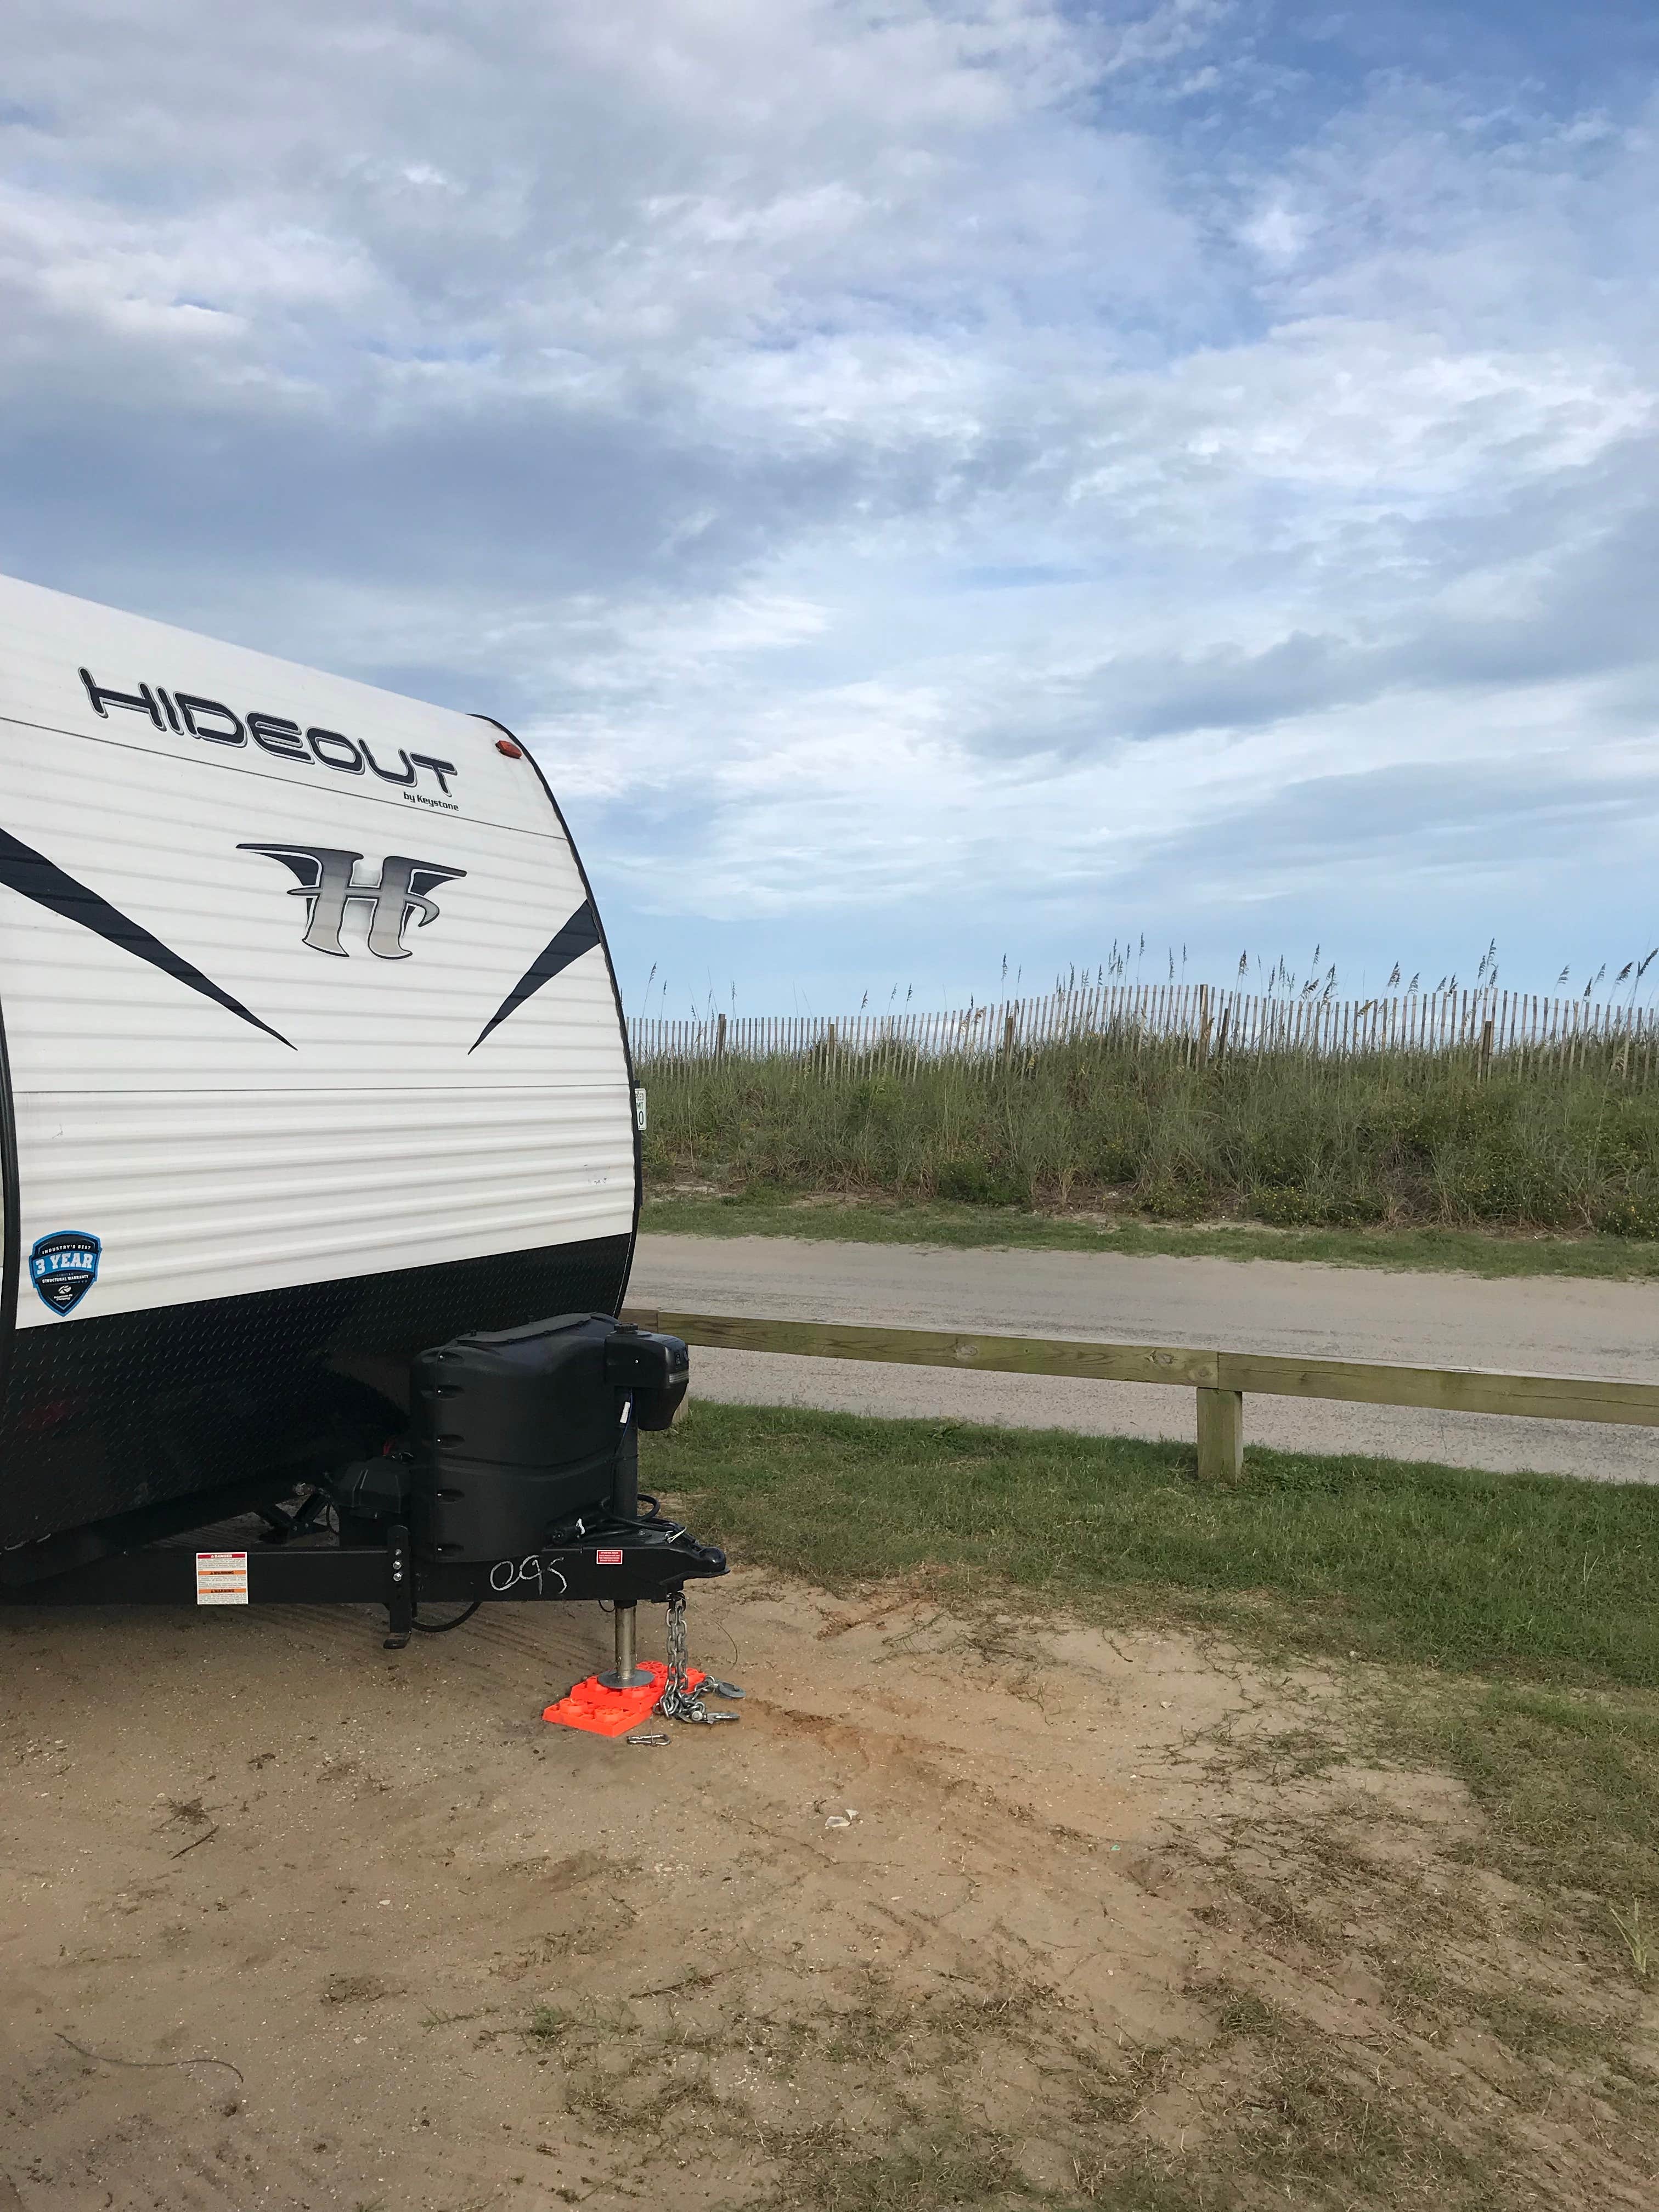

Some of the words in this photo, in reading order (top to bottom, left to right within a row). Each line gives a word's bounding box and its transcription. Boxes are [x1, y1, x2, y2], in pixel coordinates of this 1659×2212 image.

[78, 667, 457, 797] HIDEOUT
[403, 791, 416, 803] by
[416, 794, 459, 811] Keystone
[639, 1111, 644, 1125] 0
[42, 1244, 76, 1254] INDUSTRY'S
[36, 1259, 46, 1275] 3
[50, 1252, 93, 1269] YEAR
